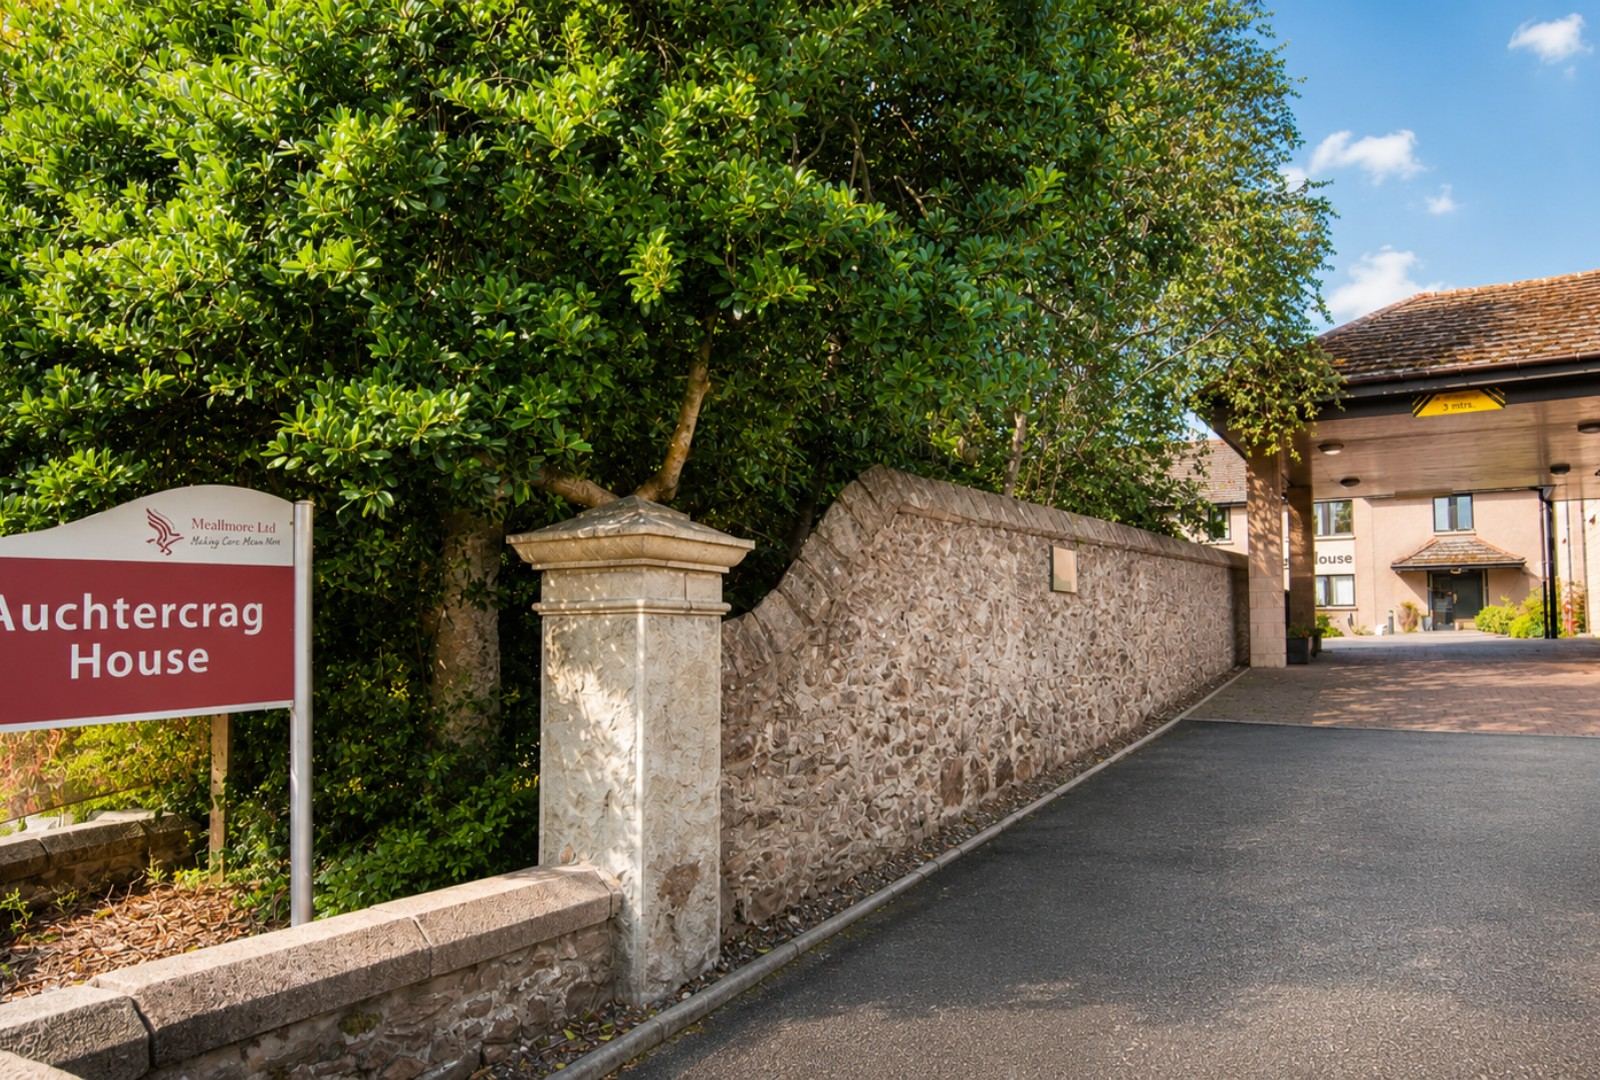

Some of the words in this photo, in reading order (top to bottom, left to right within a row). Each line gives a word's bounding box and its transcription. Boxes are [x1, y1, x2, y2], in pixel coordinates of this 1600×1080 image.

[1443, 403, 1449, 411] 3
[191, 517, 255, 532] Meallmore
[257, 521, 276, 534] Ltd
[190, 535, 219, 549] Making
[221, 536, 240, 546] Care
[70, 643, 209, 680] House
